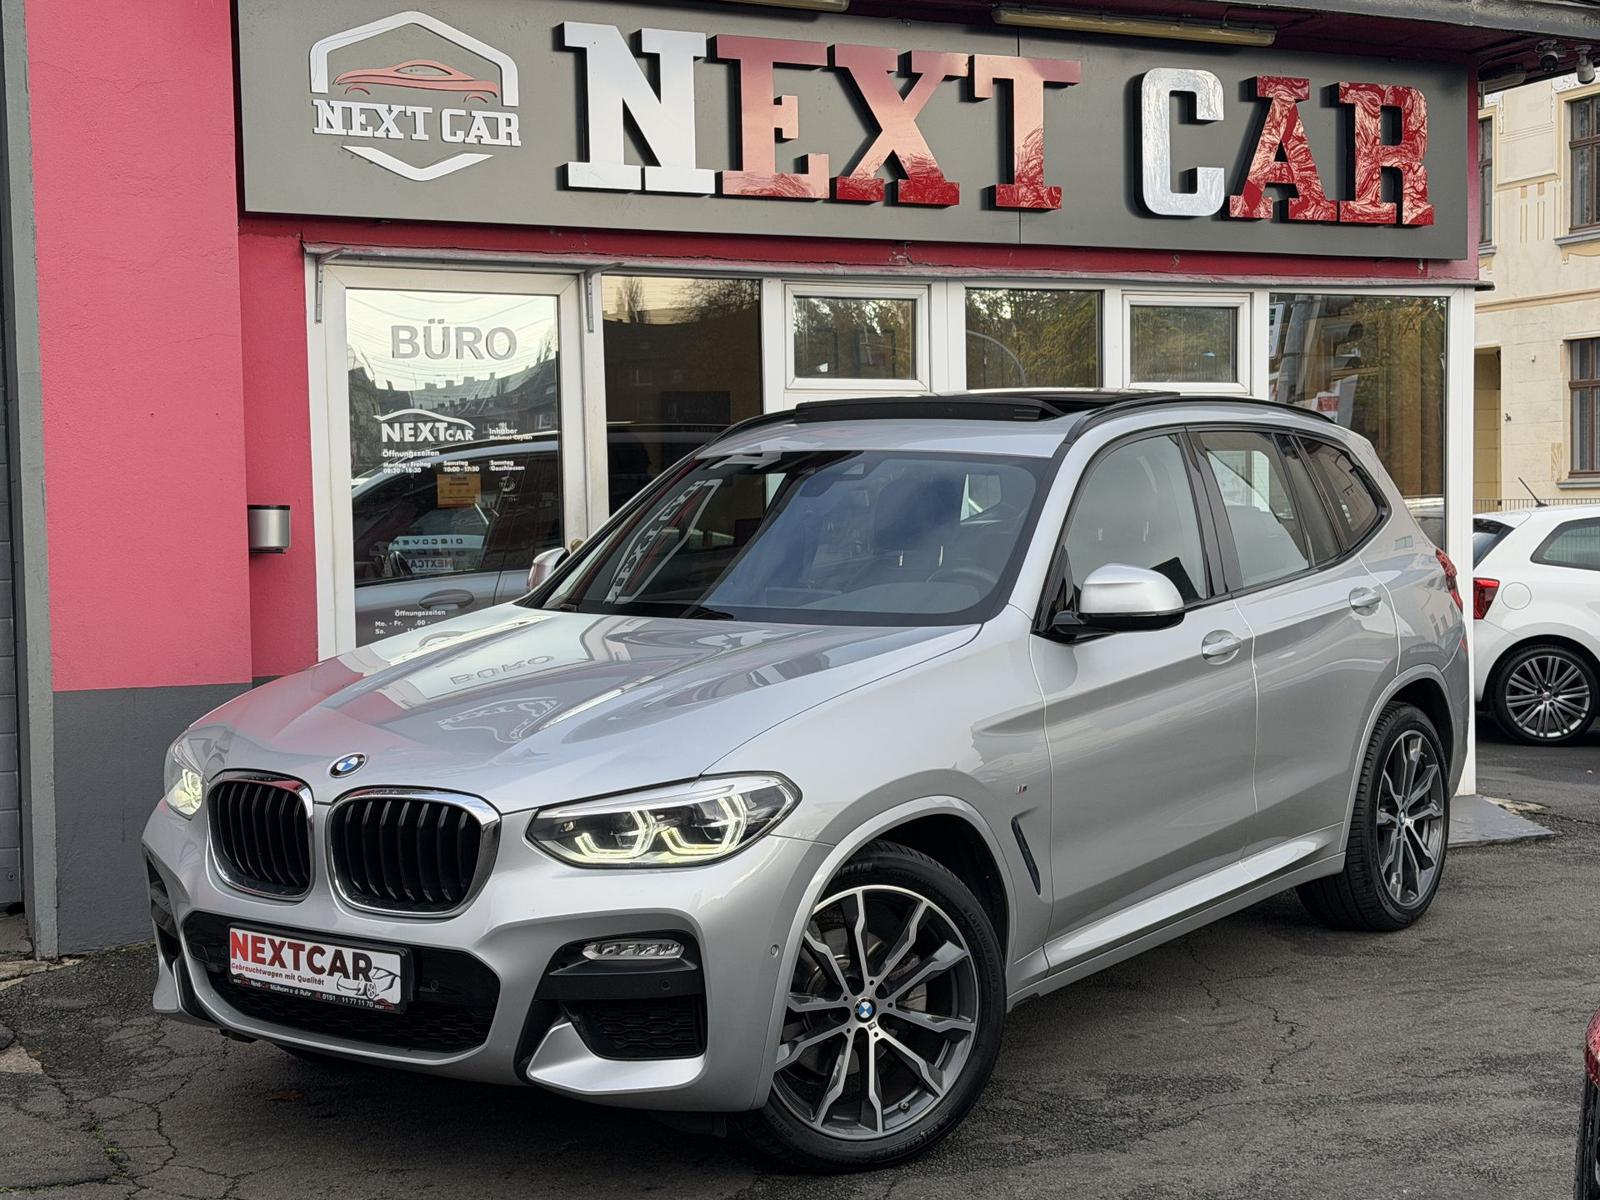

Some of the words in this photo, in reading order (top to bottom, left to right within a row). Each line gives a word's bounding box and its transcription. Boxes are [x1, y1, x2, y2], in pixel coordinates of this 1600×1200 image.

[311, 99, 433, 141] NEXT
[440, 108, 522, 147] CAR
[558, 21, 1081, 210] NEXT
[1140, 67, 1435, 226] CAR
[390, 318, 517, 361] BÜRO
[382, 449, 440, 458] Öffnungszeiten
[394, 609, 446, 617] Öffnungszeiten
[230, 931, 373, 983] NEXTCAR
[231, 962, 283, 979] Gebrauchtwagen
[284, 972, 296, 981] mit
[297, 975, 325, 987] Qualität
